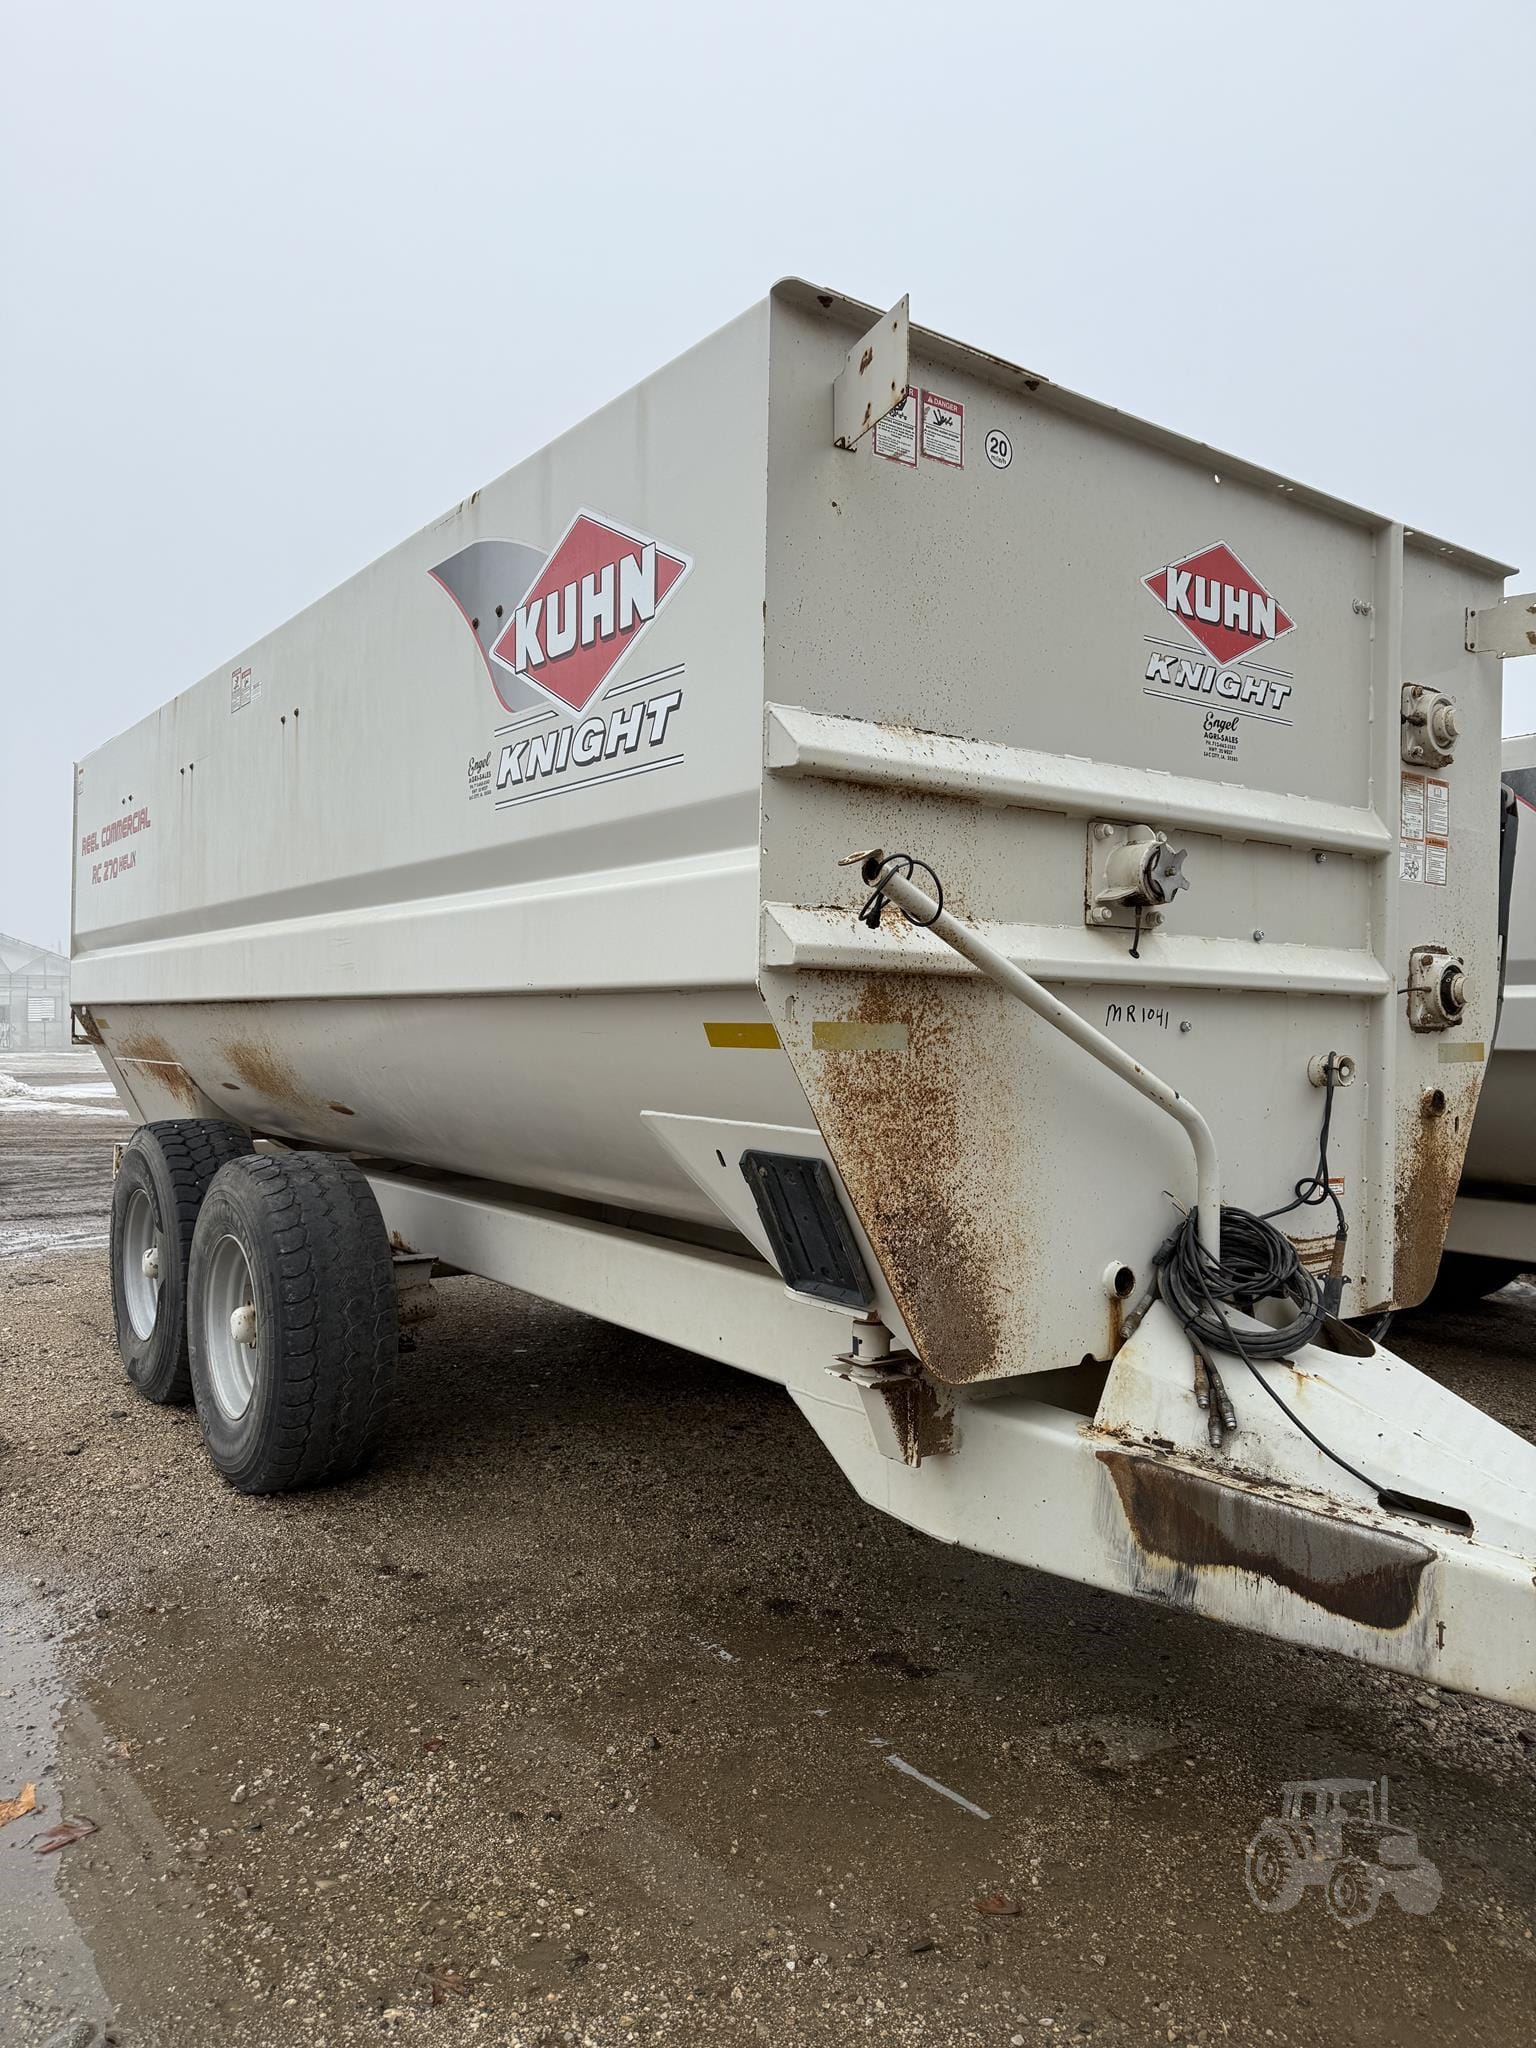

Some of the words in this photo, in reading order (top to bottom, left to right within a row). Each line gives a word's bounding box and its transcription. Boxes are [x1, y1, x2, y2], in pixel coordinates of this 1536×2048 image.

[933, 398, 958, 413] DANGER
[990, 437, 1008, 457] 20
[514, 541, 657, 674] KUHN
[1166, 566, 1277, 640] KUHN
[1145, 652, 1293, 710] KNIGHT
[495, 688, 683, 790] KNIGHT
[1203, 711, 1239, 733] Engel
[1204, 732, 1239, 744] AGRI-SALES
[81, 832, 99, 857] REEL
[101, 806, 151, 848] COMMERCIAL
[92, 863, 102, 885] RC
[103, 857, 118, 881] 270
